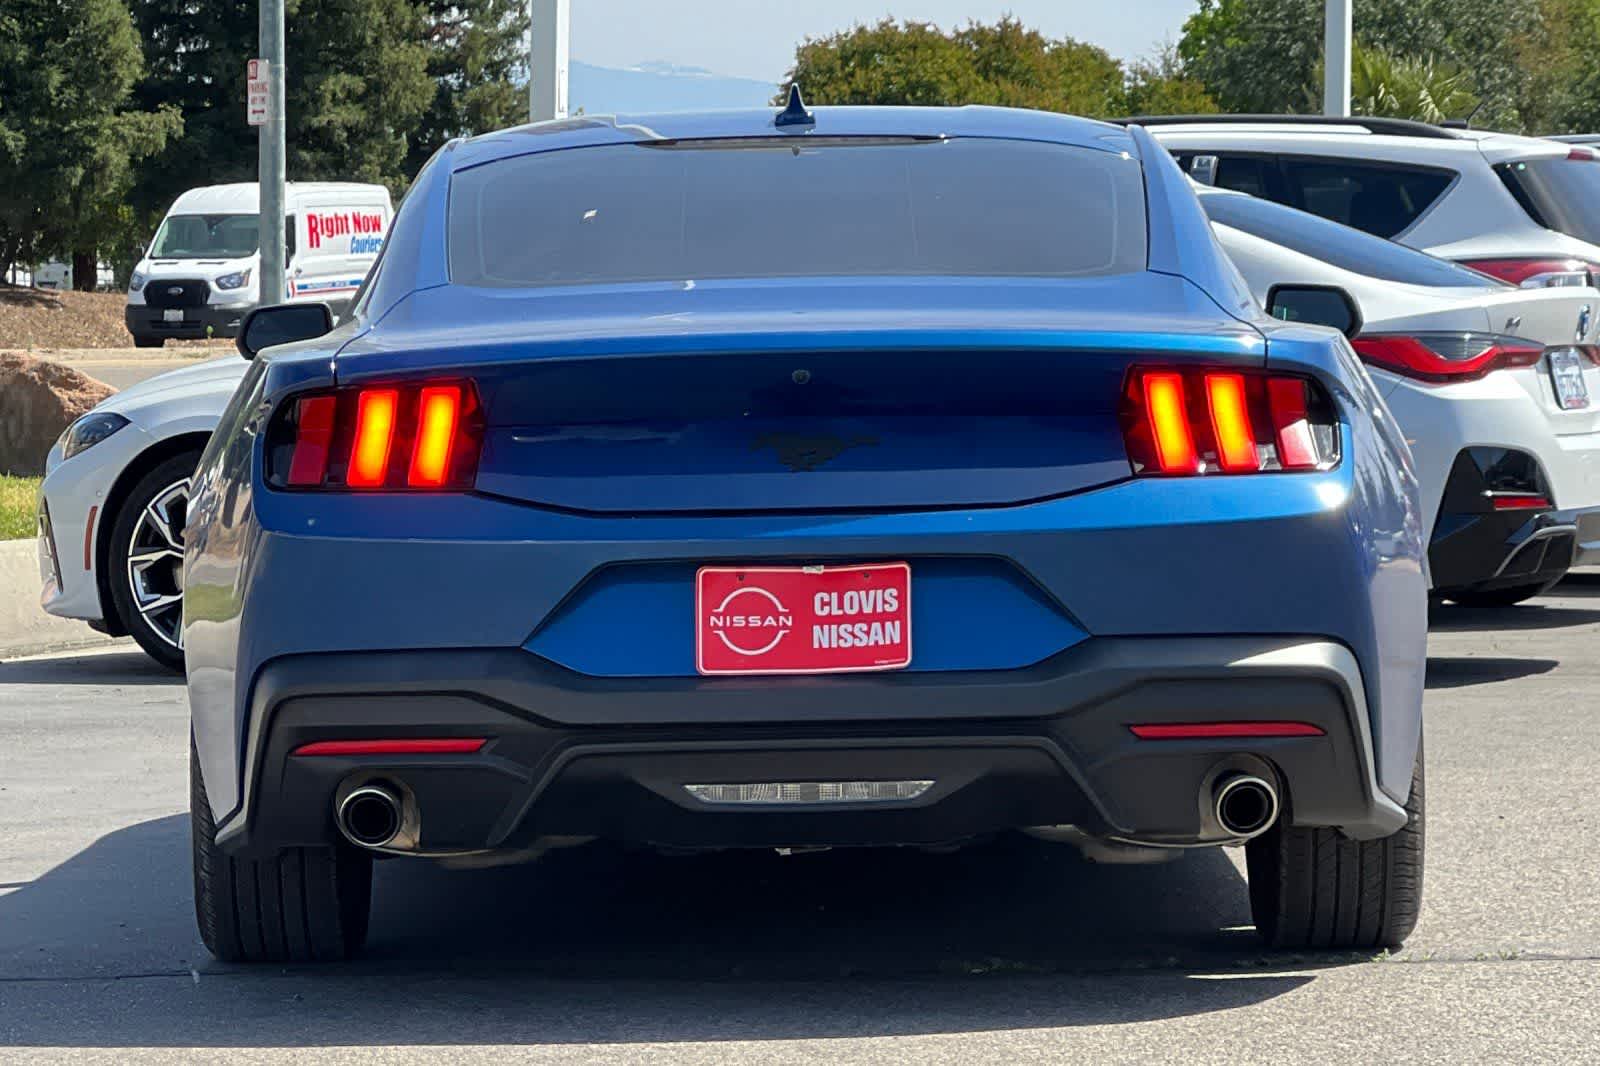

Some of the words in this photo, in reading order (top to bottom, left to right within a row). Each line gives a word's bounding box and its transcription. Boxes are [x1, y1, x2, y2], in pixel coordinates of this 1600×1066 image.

[307, 213, 350, 248] Right
[352, 212, 381, 233] Now
[814, 588, 899, 616] CLOVIS
[710, 615, 793, 627] NISSAN
[812, 620, 901, 649] NISSAN
